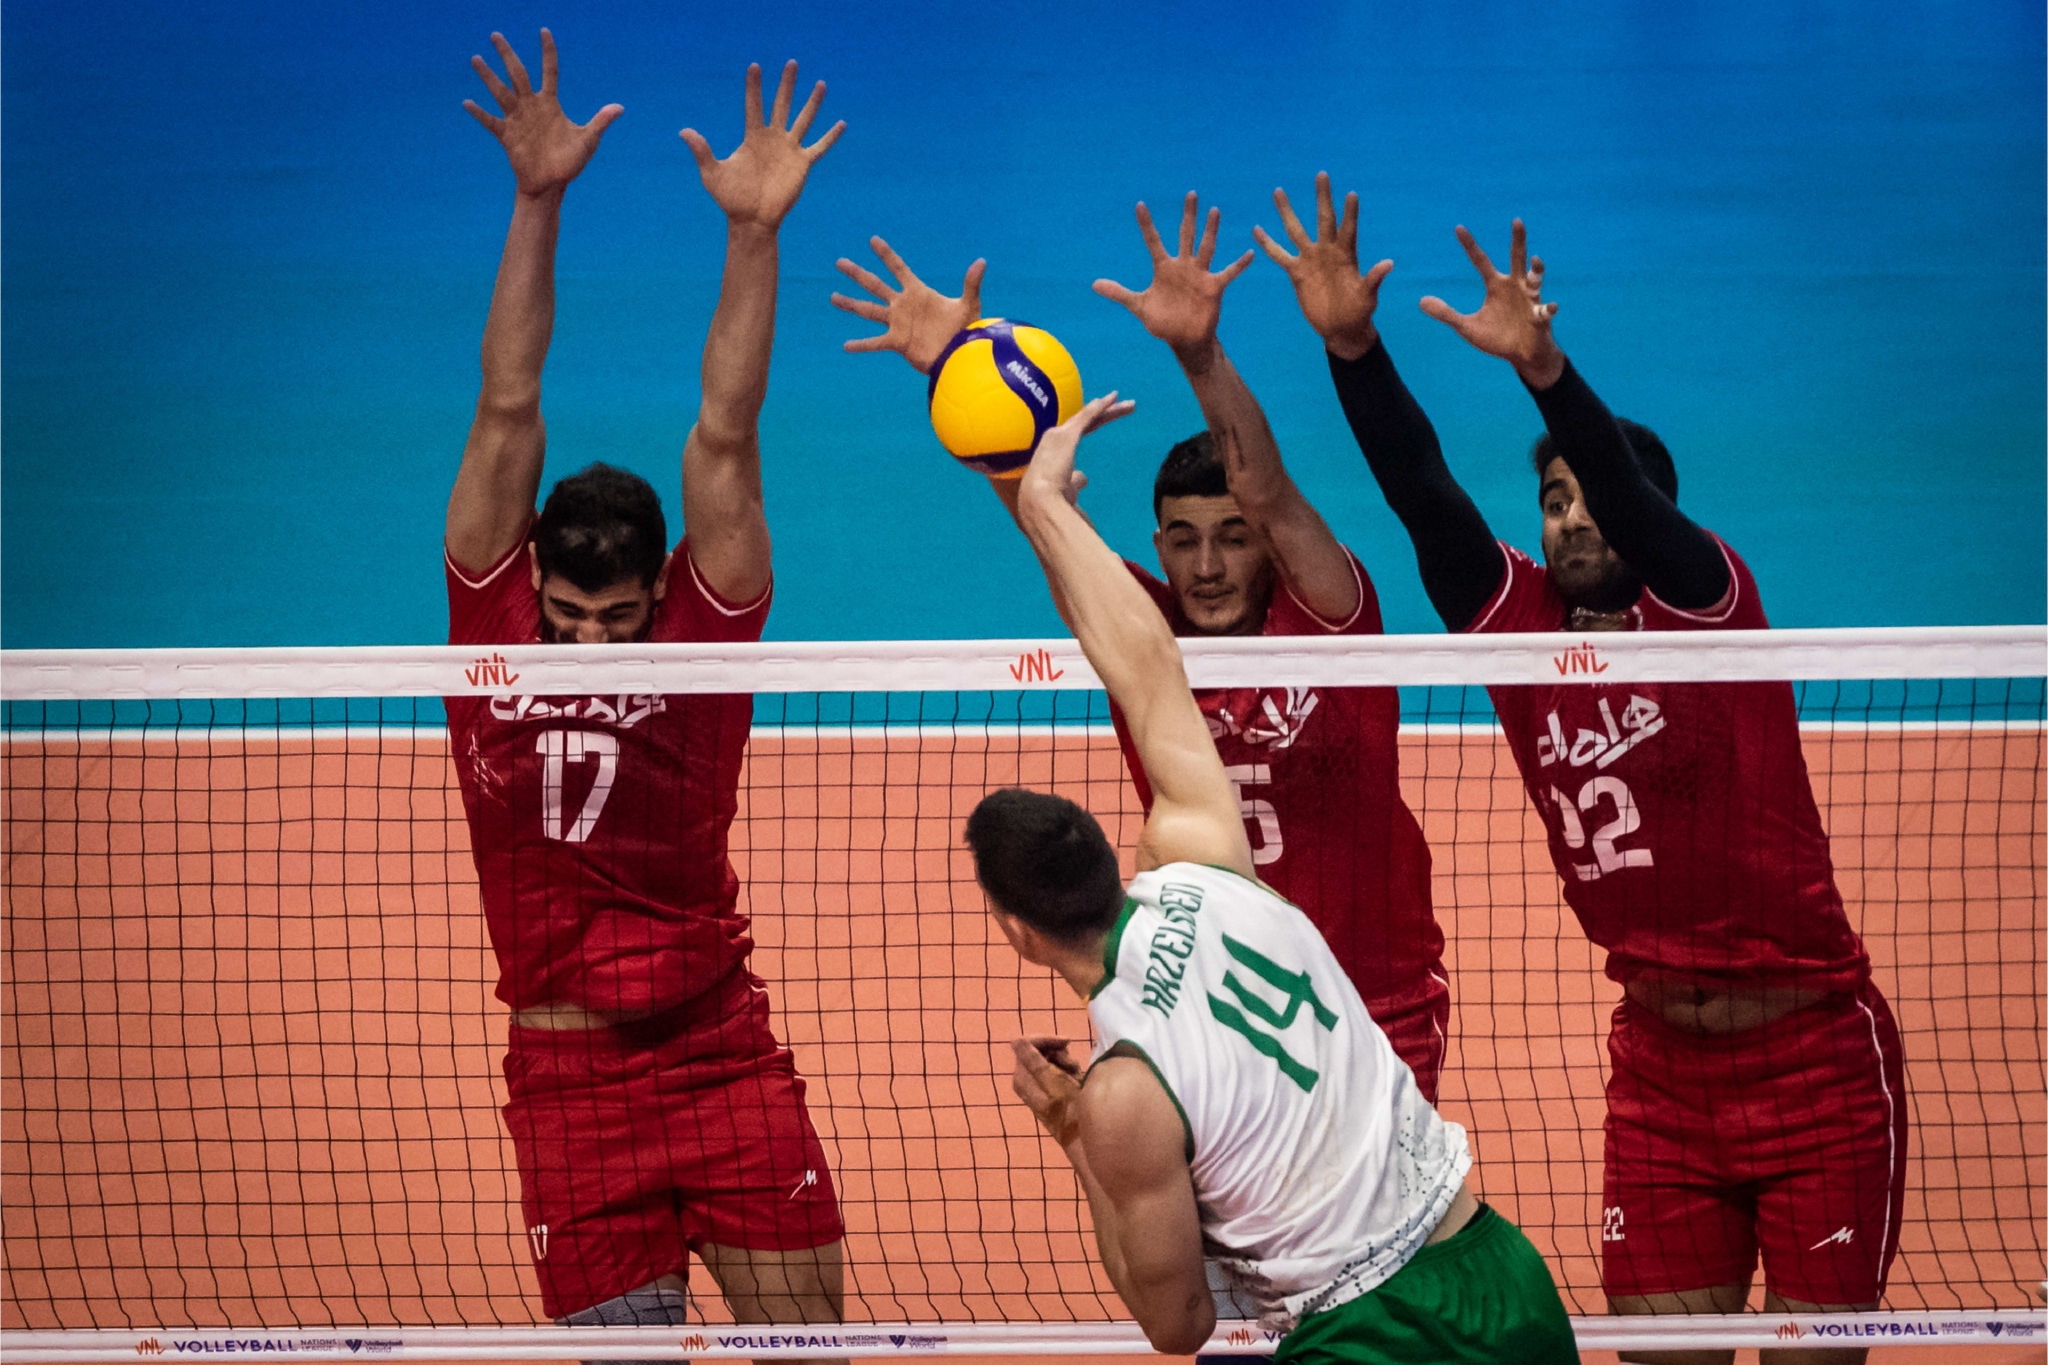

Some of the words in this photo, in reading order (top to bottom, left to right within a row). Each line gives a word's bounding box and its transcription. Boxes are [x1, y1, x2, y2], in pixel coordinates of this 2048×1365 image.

[465, 653, 519, 686] VNL
[1009, 648, 1064, 682] VNL
[1554, 641, 1609, 676] VNL
[536, 729, 620, 842] 17
[1206, 932, 1339, 1094] 14
[1603, 1206, 1625, 1241] 22
[530, 1224, 548, 1260] 17
[135, 1337, 166, 1356] VNL
[174, 1340, 298, 1353] VOLLEYBALL
[300, 1338, 337, 1346] NATIONS
[680, 1333, 711, 1351] VNL
[718, 1336, 842, 1348] VOLLEYBALL
[1226, 1328, 1257, 1346] VNL
[1774, 1321, 1806, 1340] VNL
[1813, 1323, 1938, 1337] VOLLEYBALL
